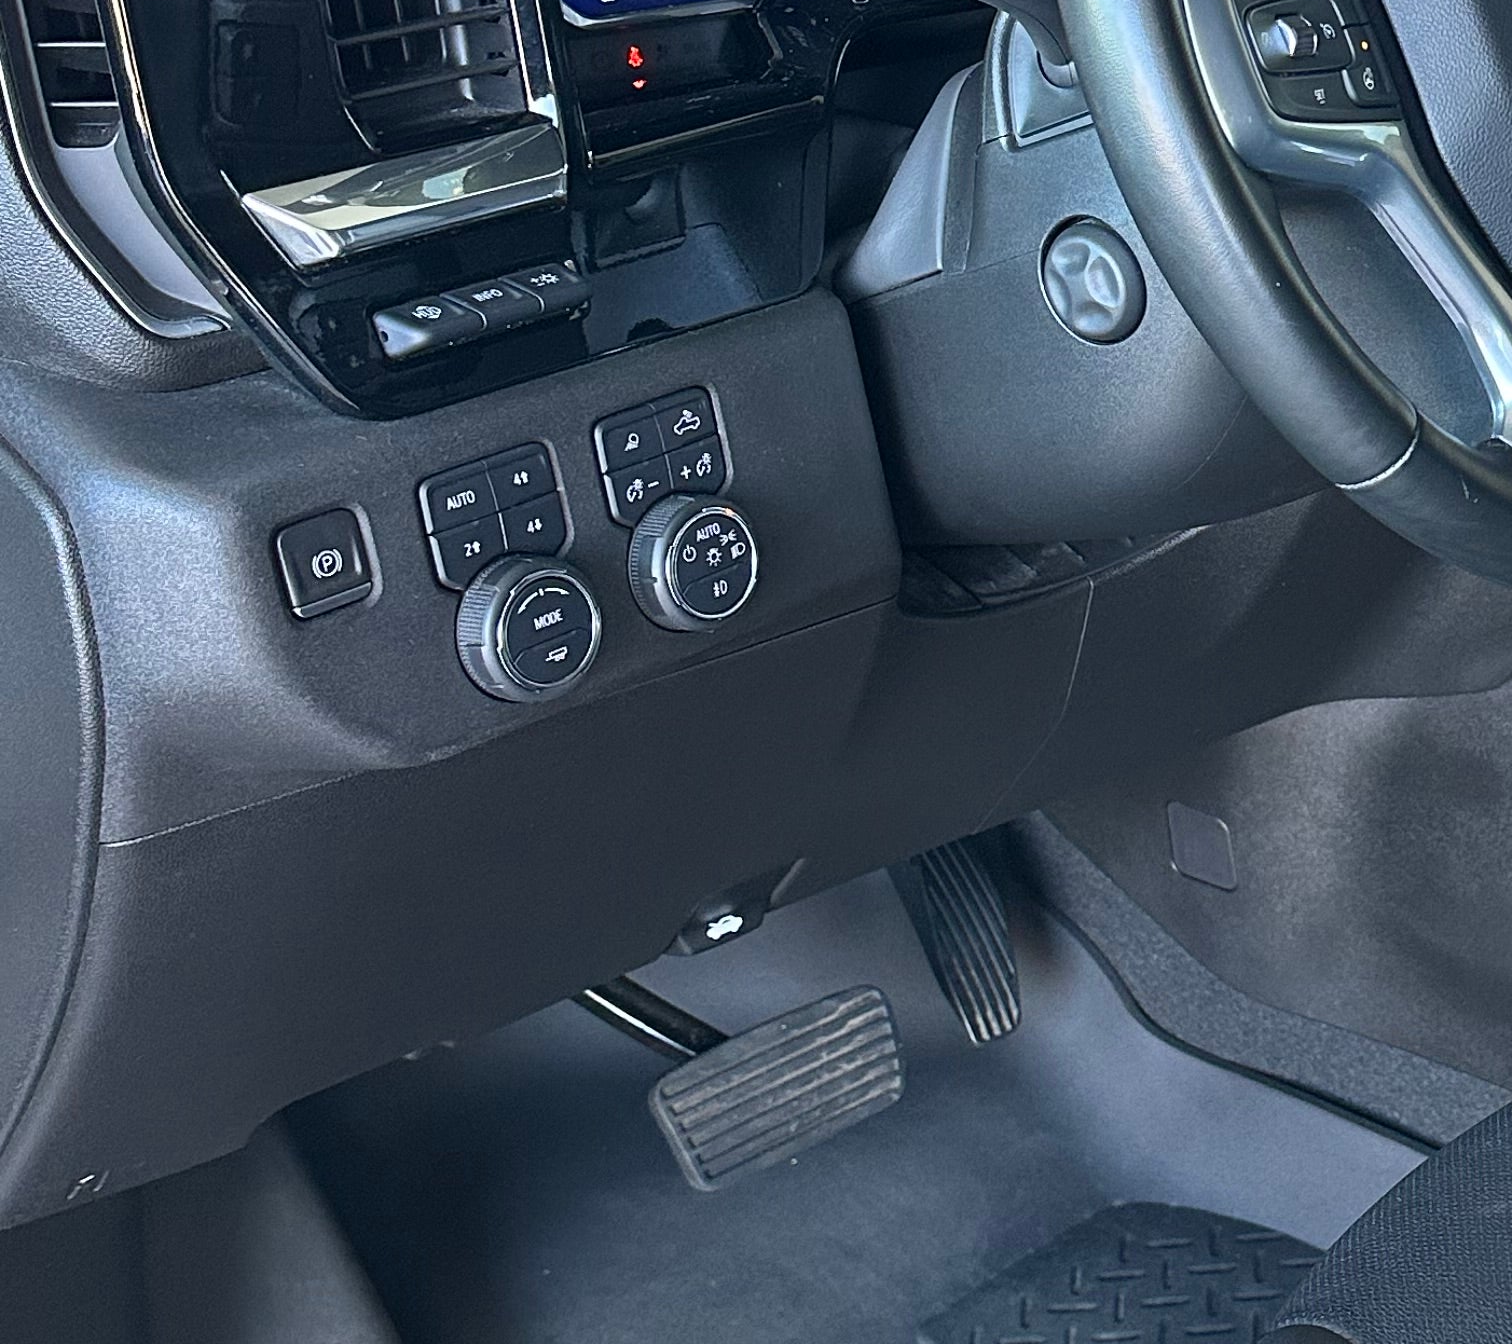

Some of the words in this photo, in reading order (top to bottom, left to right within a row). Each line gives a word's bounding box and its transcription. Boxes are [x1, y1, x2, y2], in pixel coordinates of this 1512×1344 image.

[472, 288, 504, 302] INFO
[446, 489, 476, 511] AUTO
[696, 522, 721, 543] AUTO
[533, 608, 564, 631] MODE
